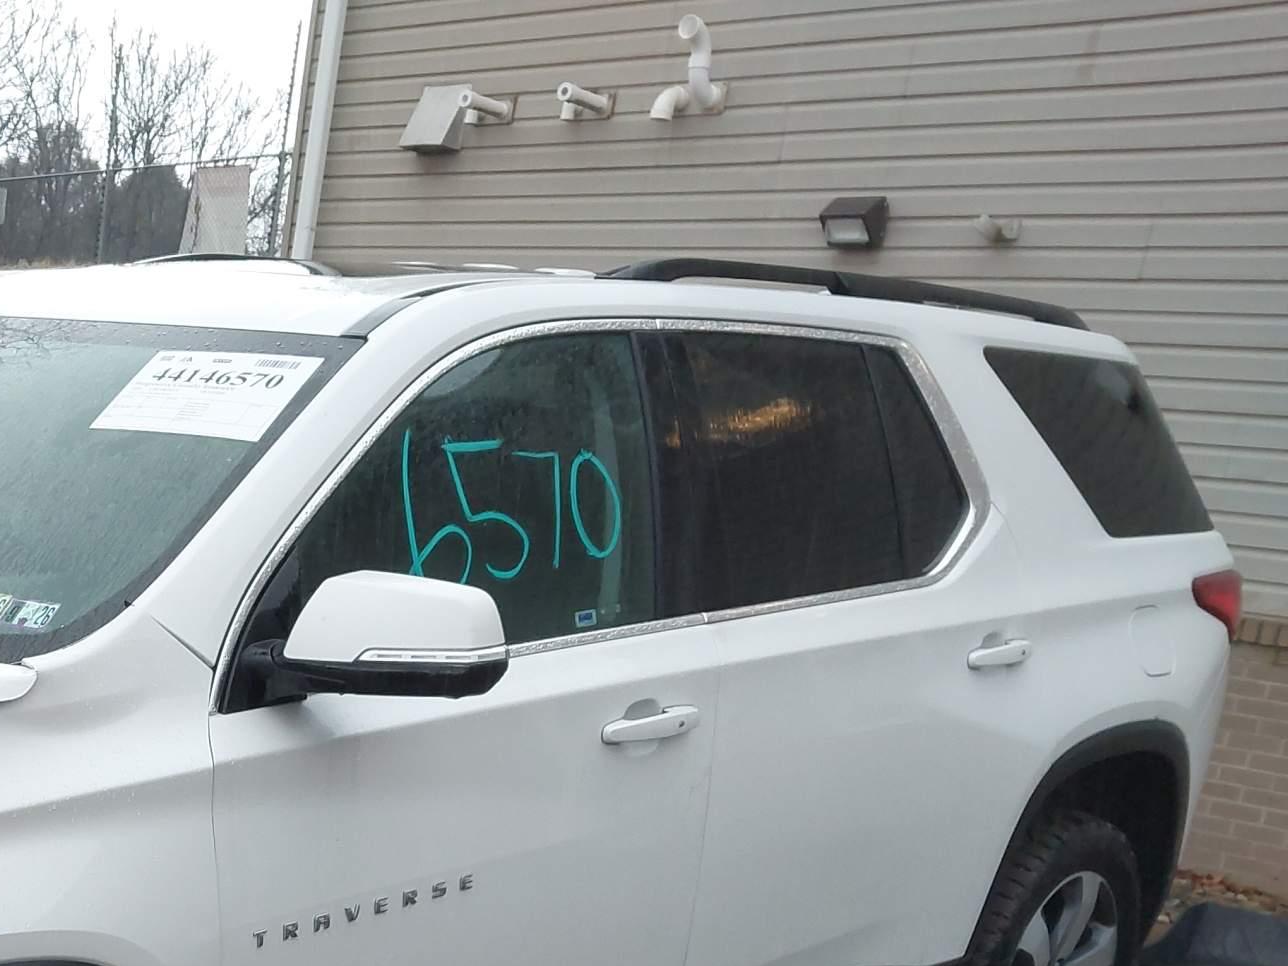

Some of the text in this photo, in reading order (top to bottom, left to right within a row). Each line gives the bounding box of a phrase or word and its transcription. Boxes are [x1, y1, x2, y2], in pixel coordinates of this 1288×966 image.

[151, 367, 285, 389] 44146570
[401, 427, 622, 585] 6570
[33, 605, 56, 626] 26
[252, 873, 474, 949] TRAVERSE
